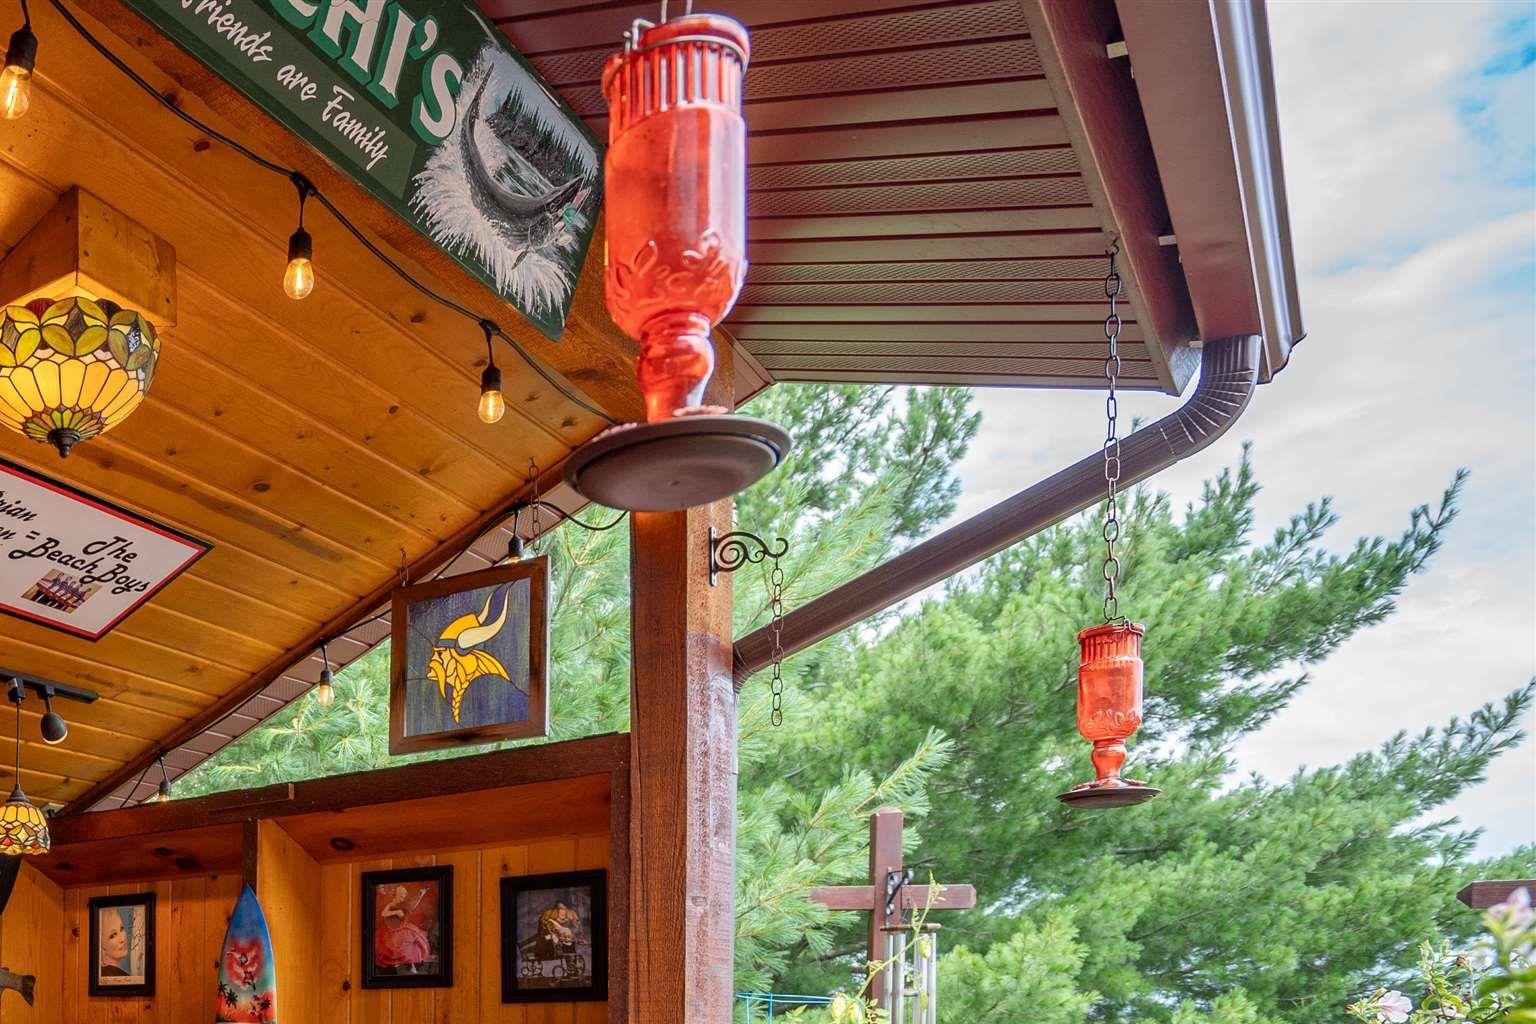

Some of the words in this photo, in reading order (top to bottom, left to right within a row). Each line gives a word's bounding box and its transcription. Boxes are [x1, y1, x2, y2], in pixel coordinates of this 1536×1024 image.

[182, 0, 273, 62] riends
[277, 64, 317, 101] are
[322, 84, 389, 171] Family
[286, 0, 463, 139] HI'S
[8, 536, 106, 575] Beach
[79, 562, 151, 595] Boys
[82, 535, 138, 563] The
